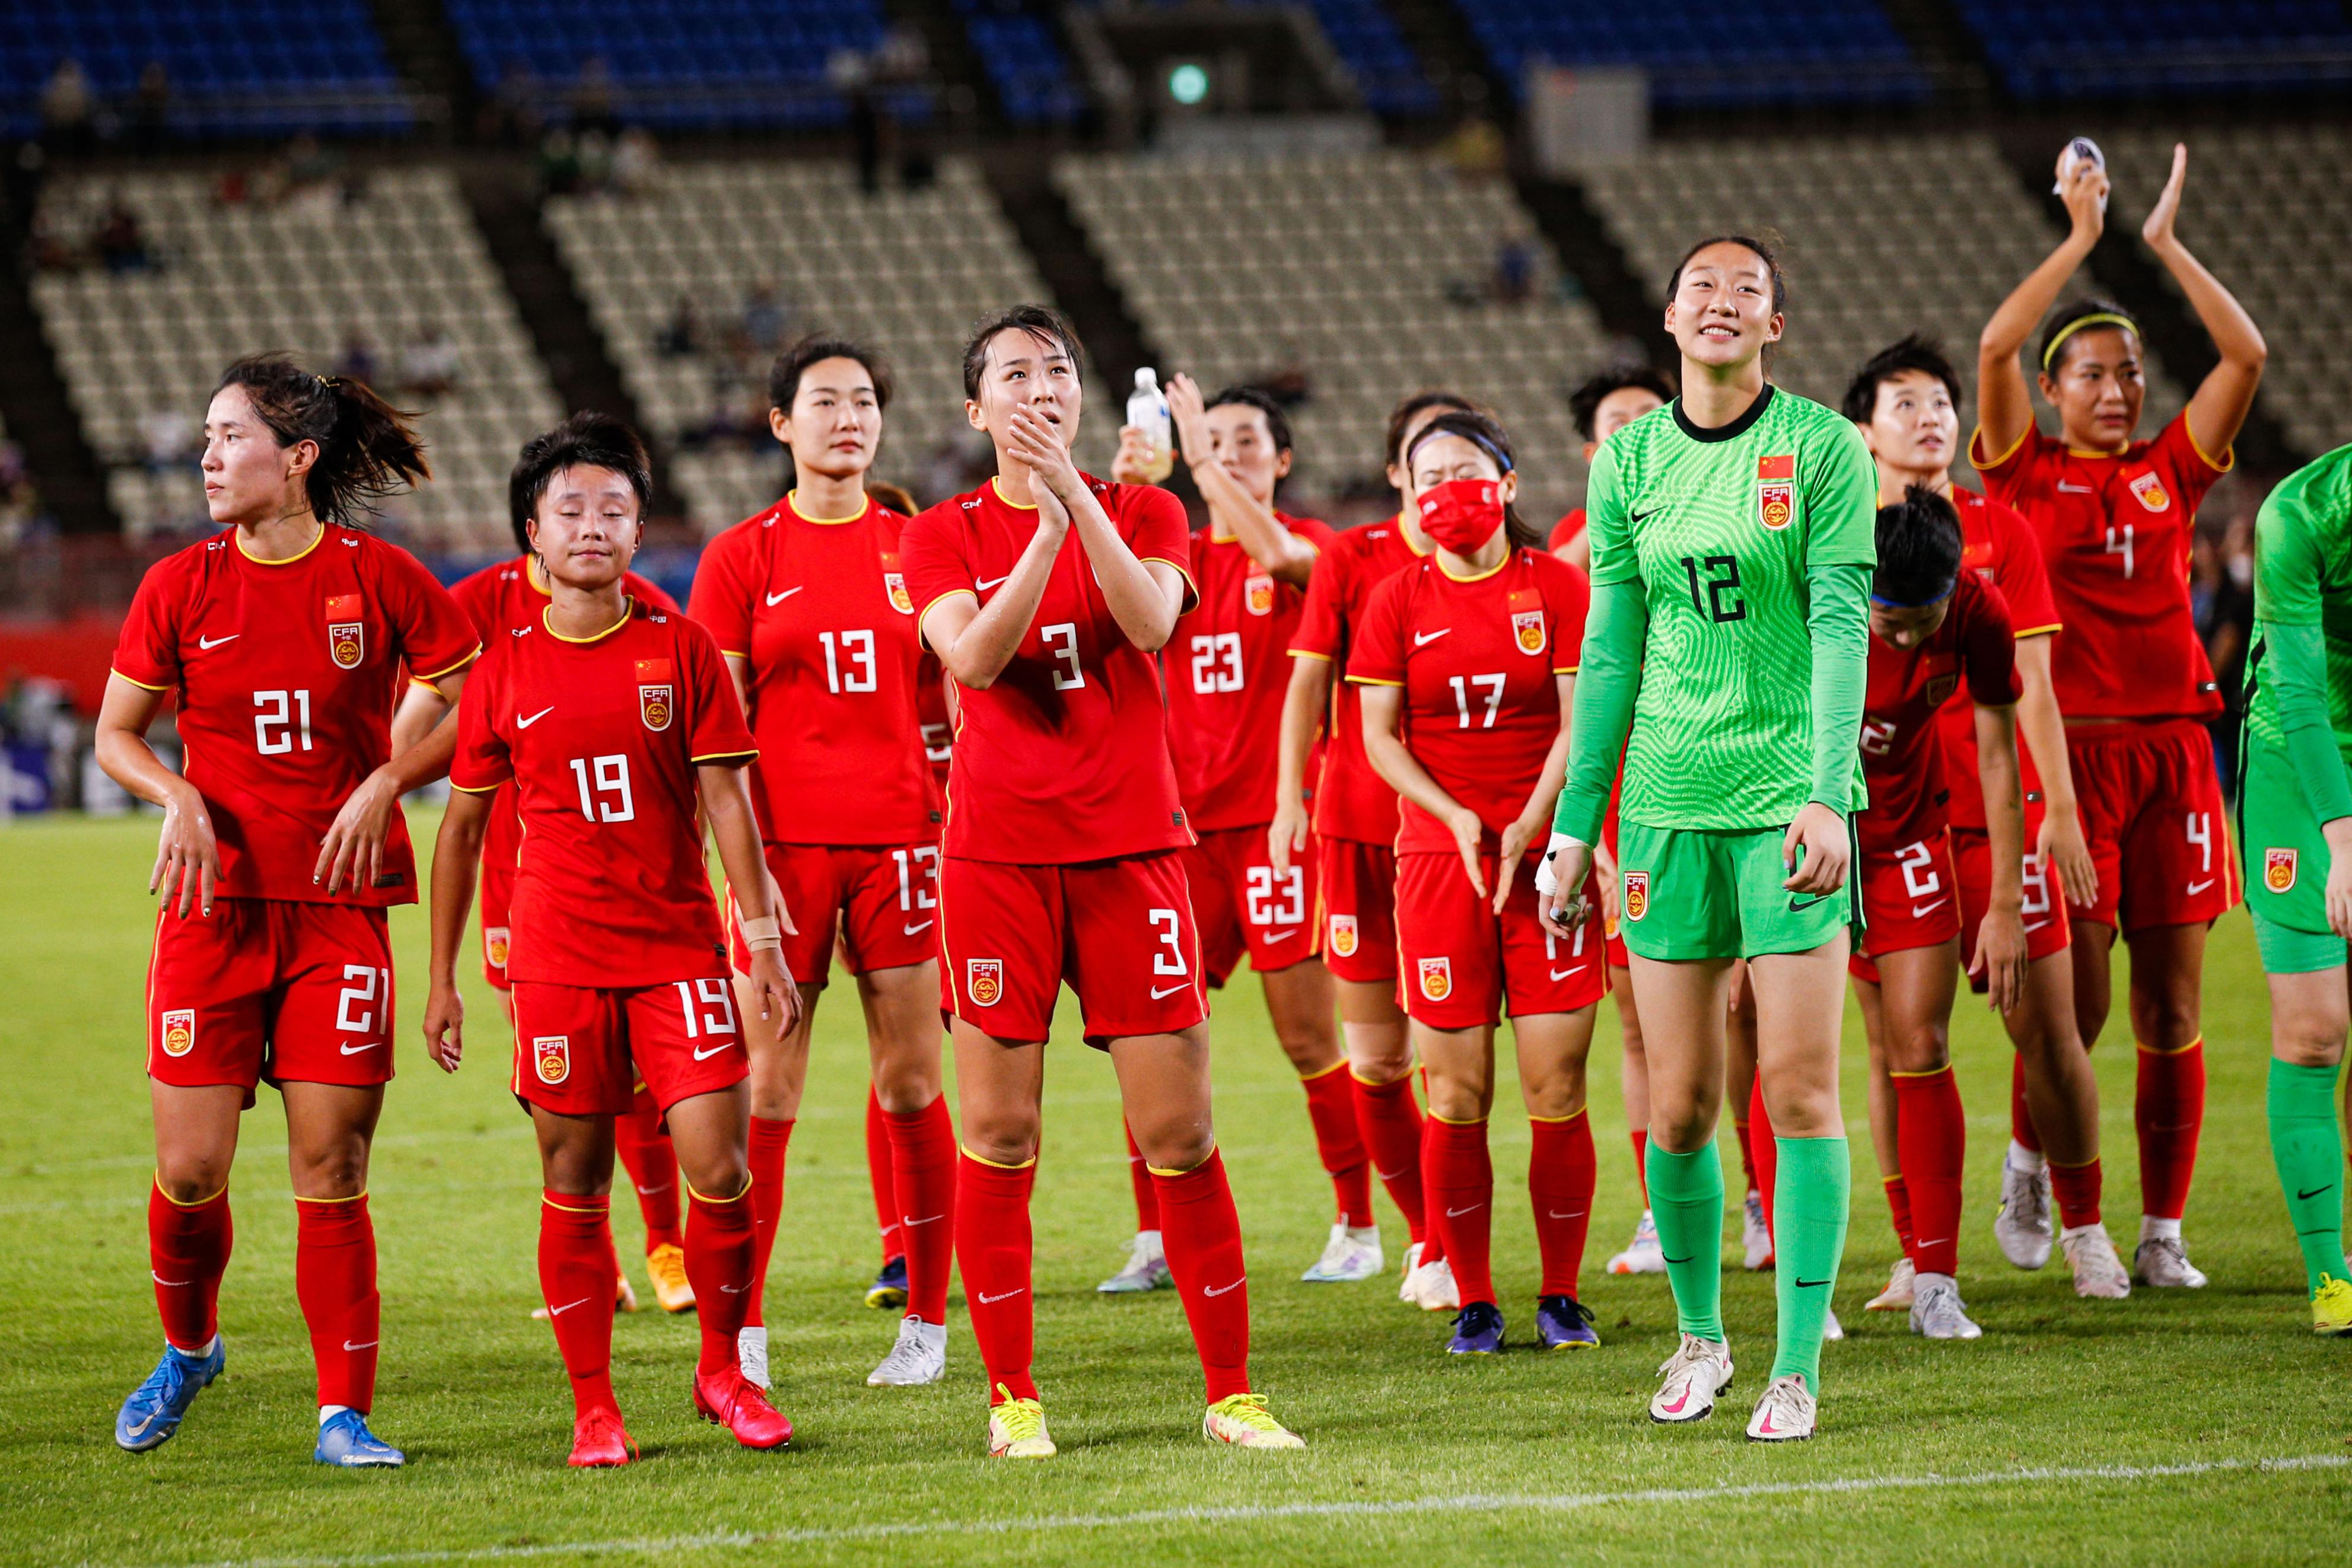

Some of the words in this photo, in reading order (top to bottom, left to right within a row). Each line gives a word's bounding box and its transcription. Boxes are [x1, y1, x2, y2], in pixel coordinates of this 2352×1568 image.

[962, 497, 983, 509] CFA
[1763, 488, 1788, 498] CFA
[2106, 524, 2134, 579] 4
[1681, 556, 1746, 623] 12
[333, 627, 358, 636] CFA
[511, 626, 532, 638] CFA
[649, 614, 667, 623] 中国
[819, 629, 877, 694] 13
[1040, 623, 1086, 690] 3
[1191, 632, 1245, 694] 23
[254, 690, 313, 754] 21
[644, 689, 668, 698] CFA
[1449, 673, 1507, 728] 17
[569, 754, 635, 823] 19
[1894, 841, 1940, 898] 2
[2186, 812, 2212, 872] 4
[892, 845, 940, 911] 13
[1247, 865, 1305, 925] 23
[1627, 877, 1645, 885] CFA
[973, 964, 998, 972] CFA
[1149, 909, 1188, 976] 3
[167, 1014, 190, 1024] CFA
[336, 964, 389, 1035] 21
[672, 978, 736, 1038] 19
[539, 1041, 564, 1051] CFA
